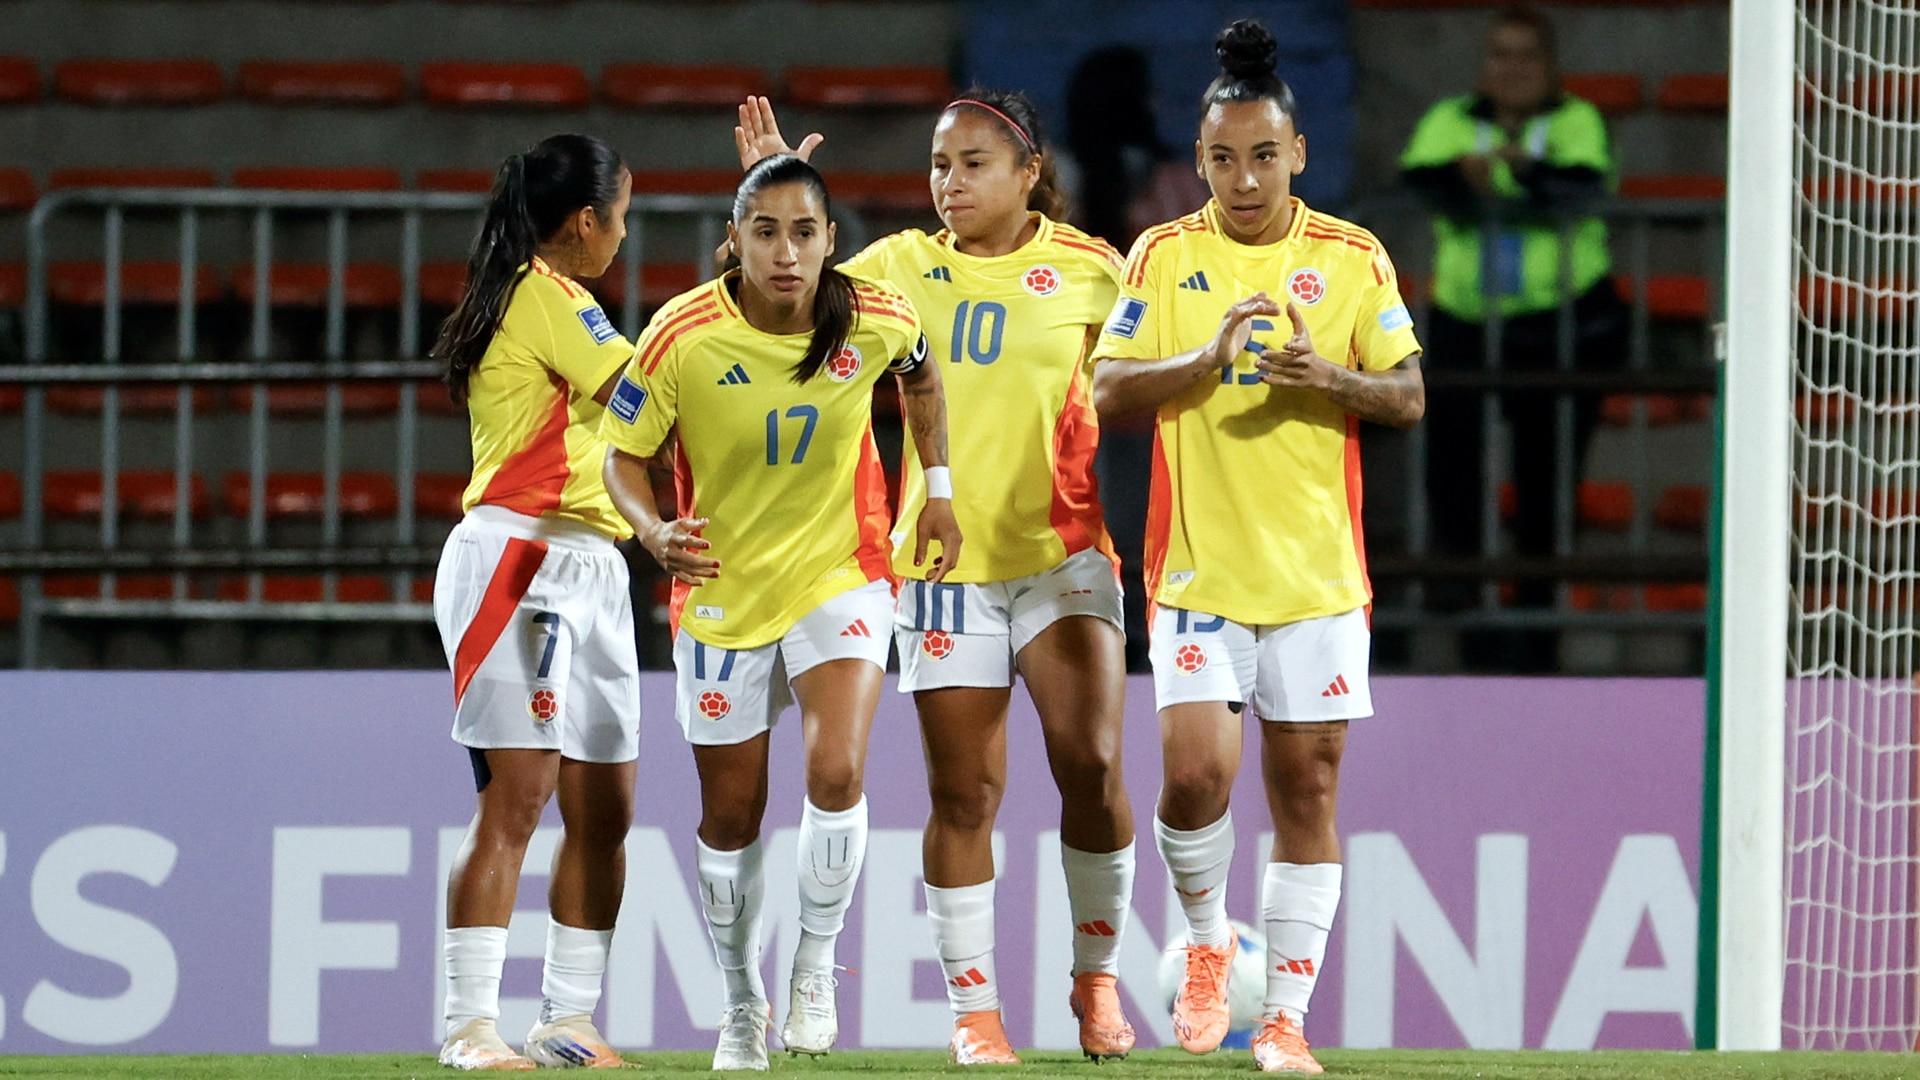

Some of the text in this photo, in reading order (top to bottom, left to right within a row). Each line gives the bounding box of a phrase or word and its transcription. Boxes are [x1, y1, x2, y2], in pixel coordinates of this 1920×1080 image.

[951, 300, 1007, 365] 10
[766, 404, 819, 466] 17
[533, 611, 560, 678] 7
[0, 824, 1700, 1050] S FEMENNA
